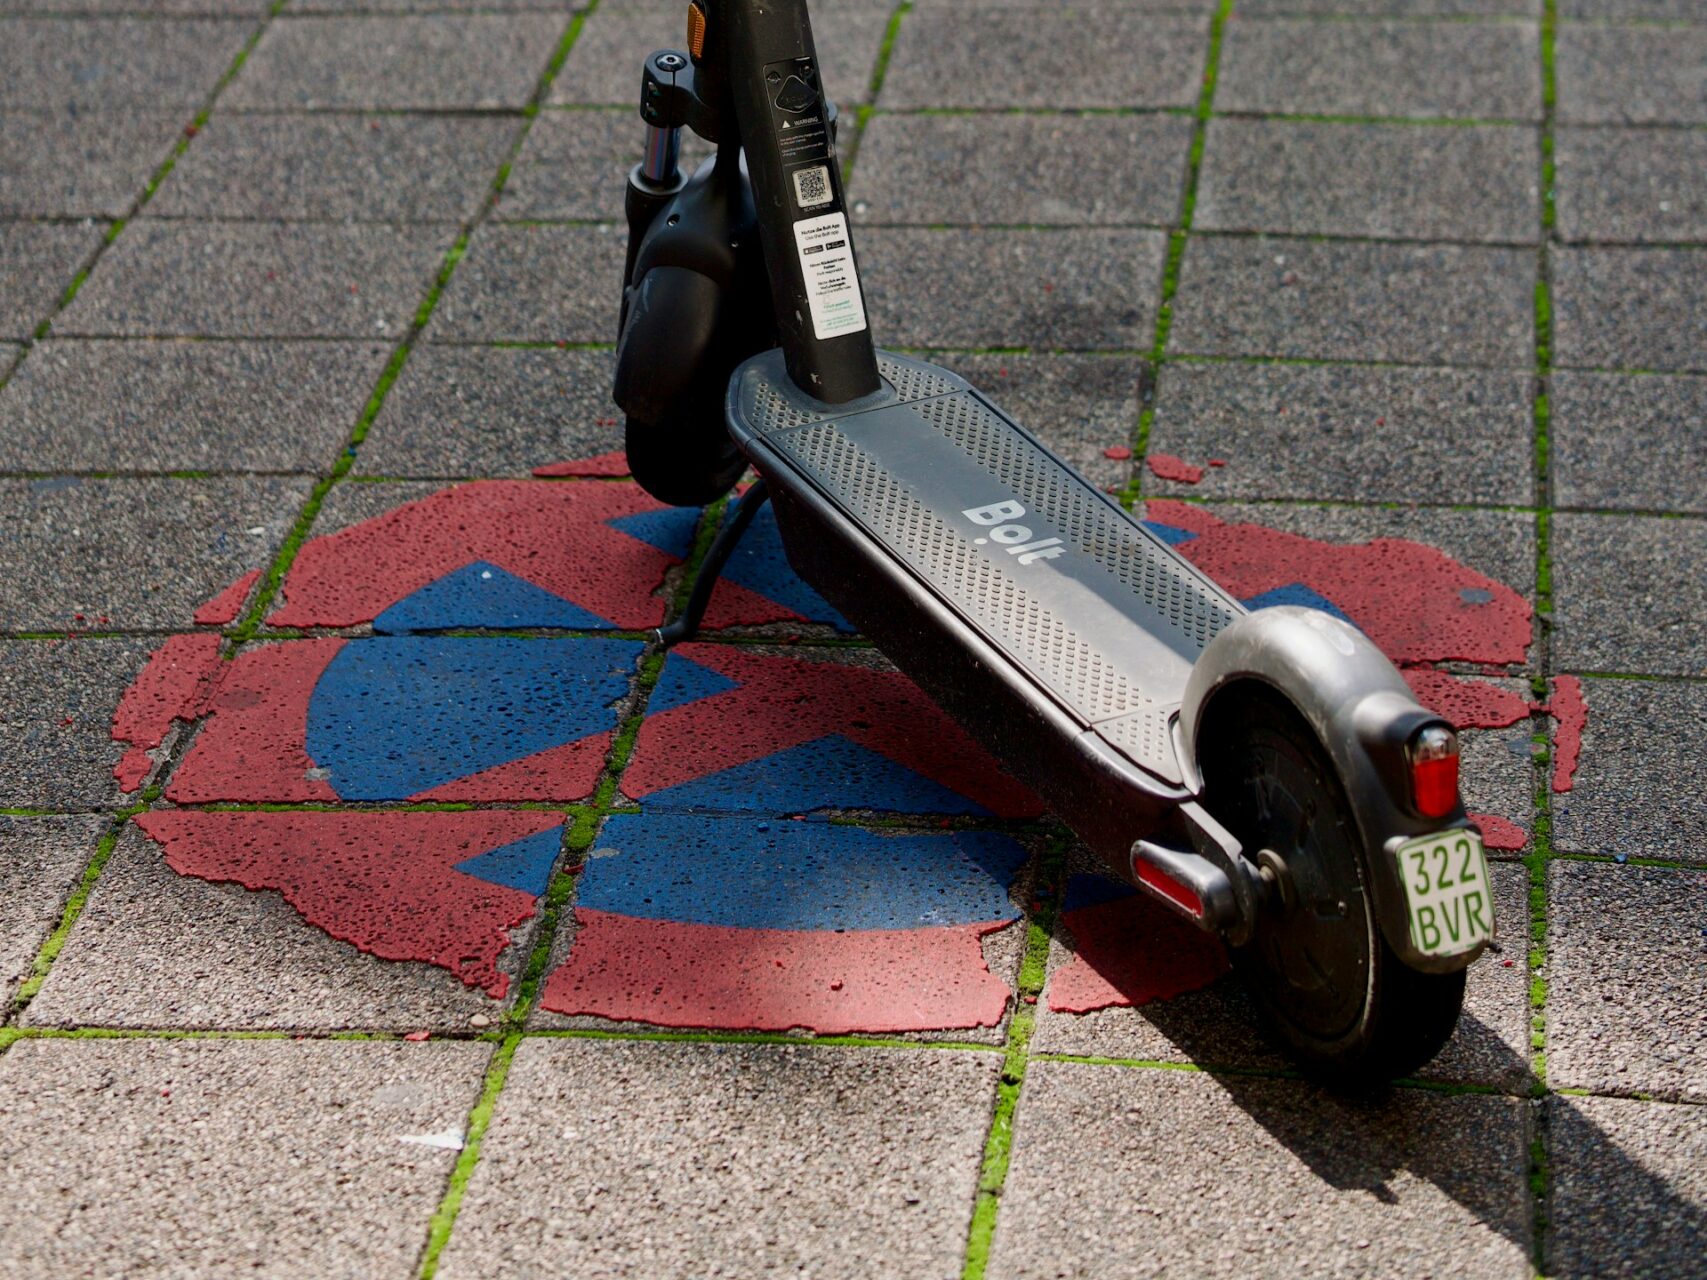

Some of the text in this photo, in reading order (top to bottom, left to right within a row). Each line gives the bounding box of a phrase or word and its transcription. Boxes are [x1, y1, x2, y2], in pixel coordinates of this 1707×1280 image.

[794, 116, 818, 125] WARNING
[961, 499, 1067, 566] Bolt
[1409, 839, 1477, 896] 322
[1416, 890, 1491, 951] BVR
